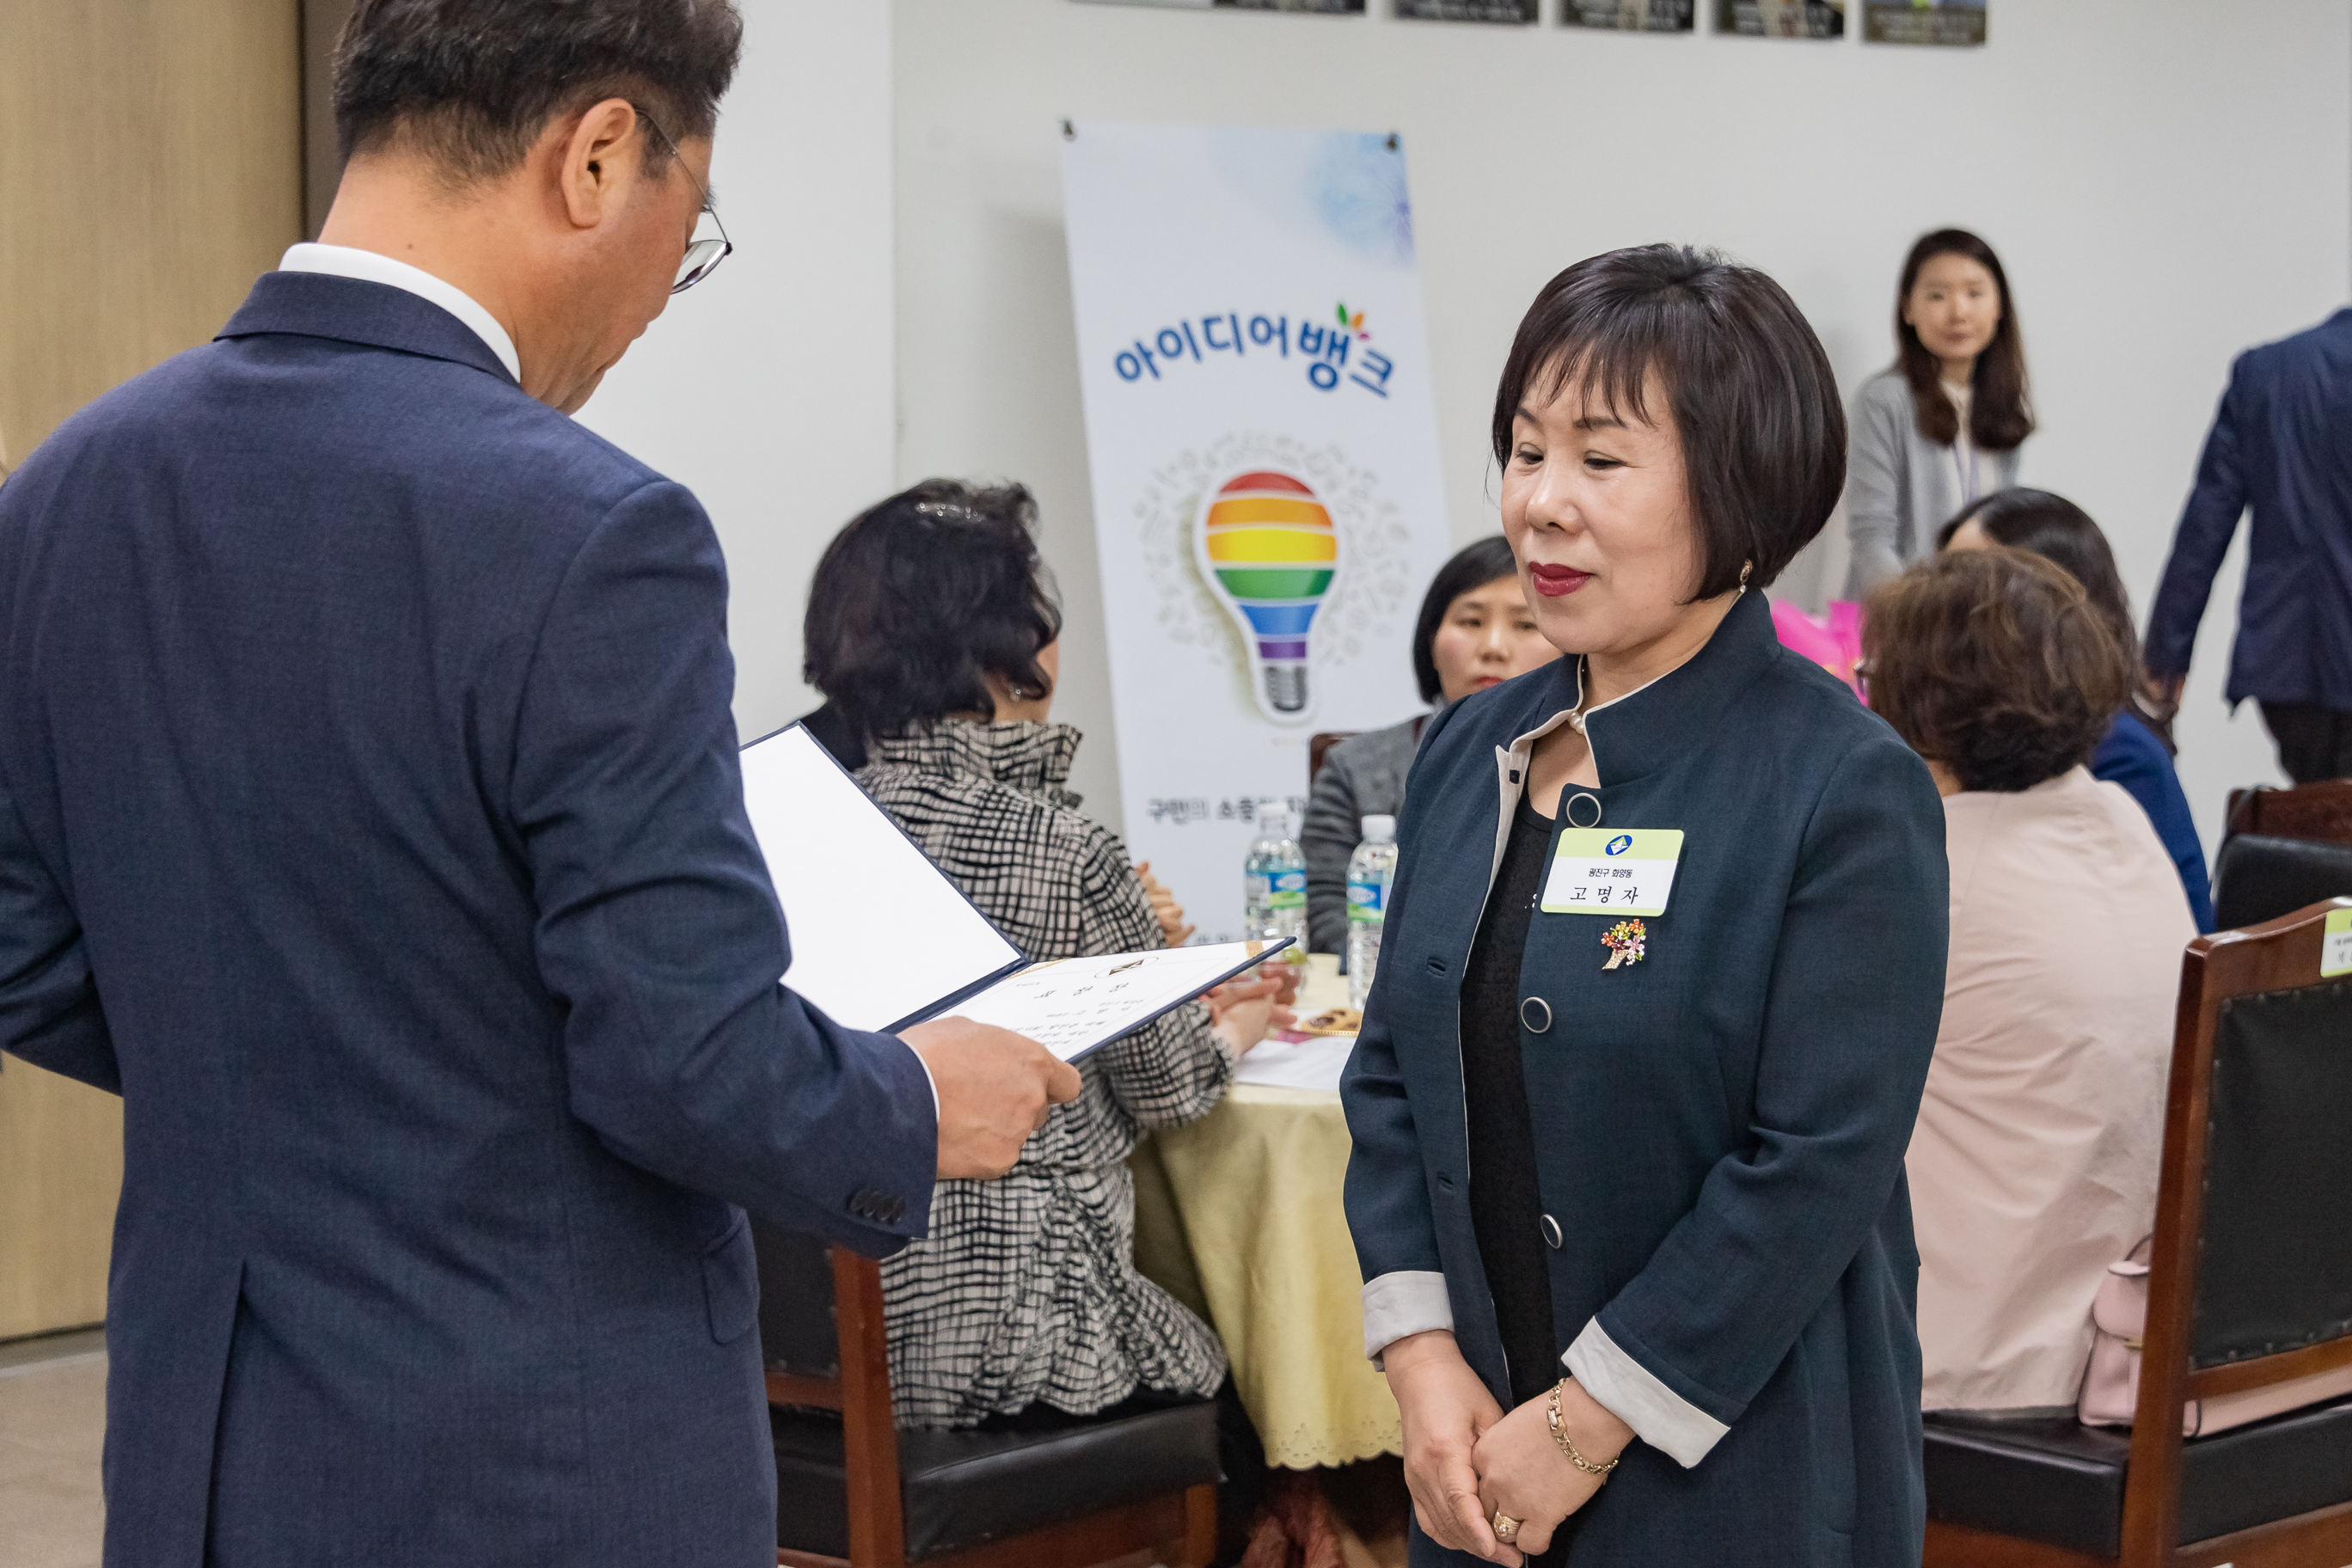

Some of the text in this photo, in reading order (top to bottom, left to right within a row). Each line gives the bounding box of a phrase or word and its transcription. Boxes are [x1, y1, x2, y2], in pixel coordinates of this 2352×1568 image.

[1113, 312, 1394, 399] 아이디어뱅크
[1589, 868, 1632, 878] 광진구 화양동
